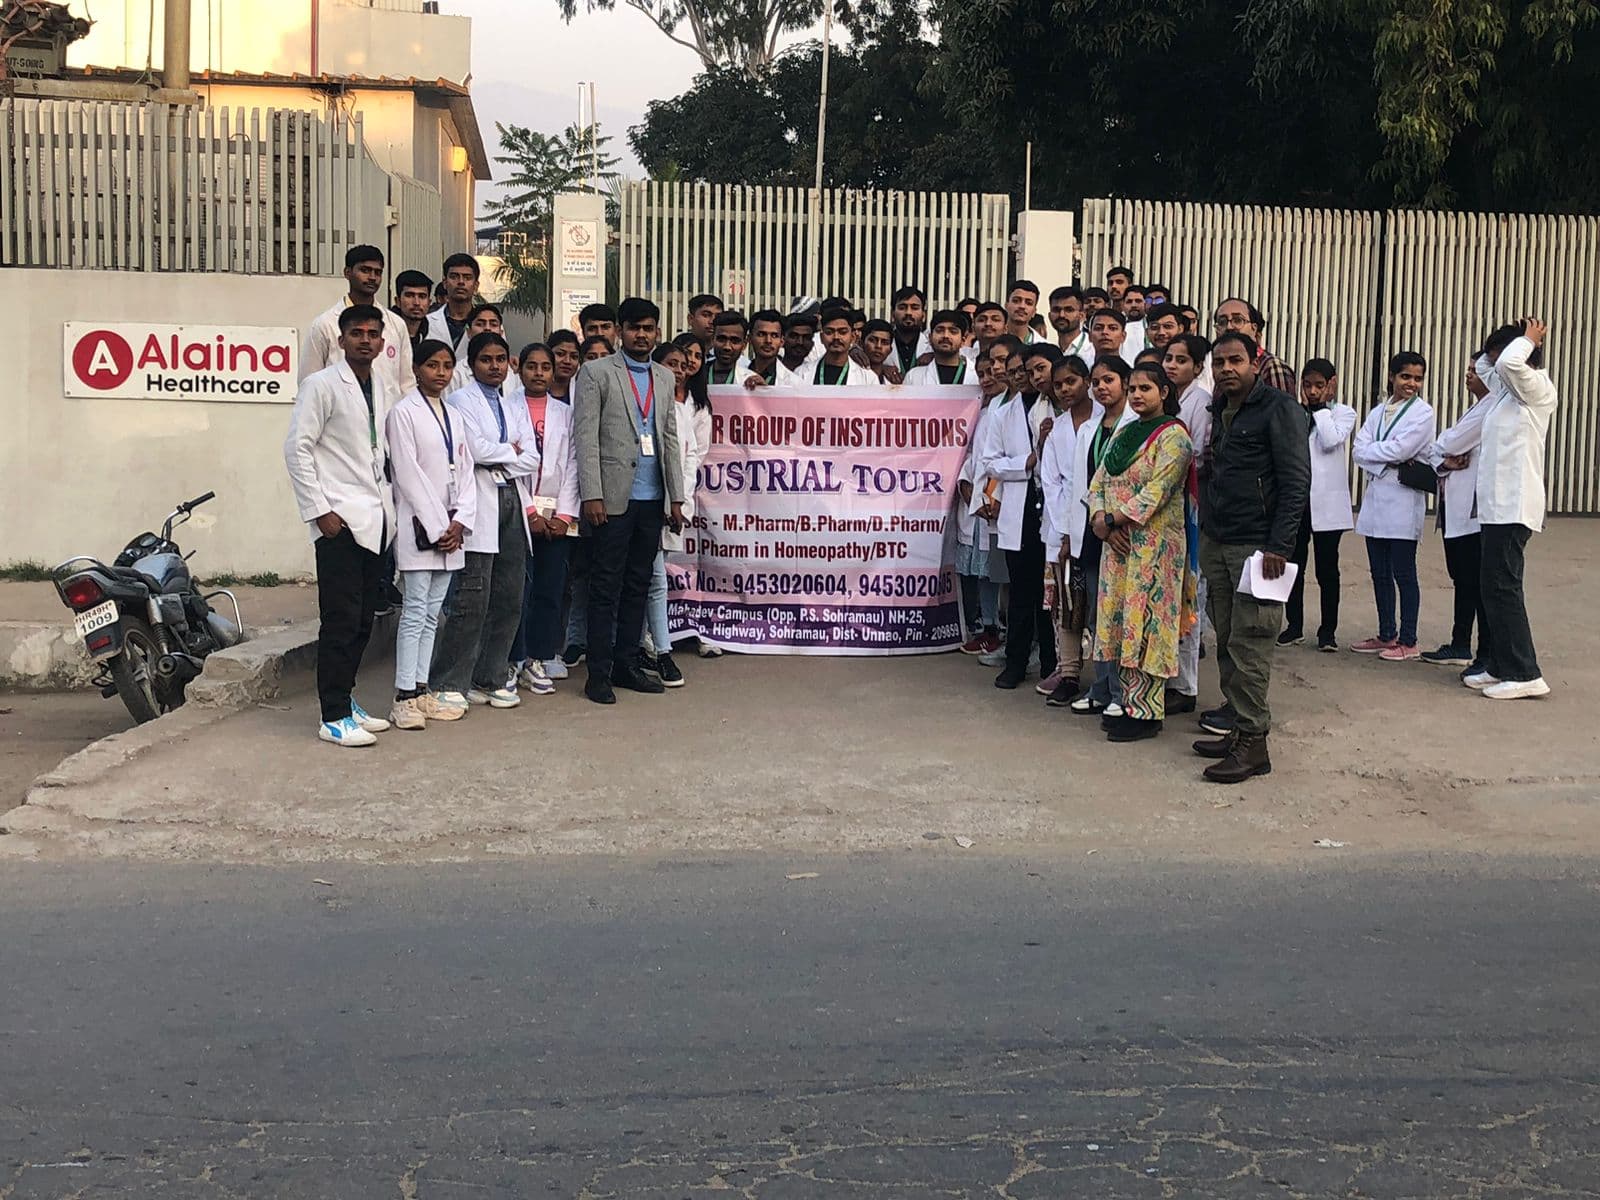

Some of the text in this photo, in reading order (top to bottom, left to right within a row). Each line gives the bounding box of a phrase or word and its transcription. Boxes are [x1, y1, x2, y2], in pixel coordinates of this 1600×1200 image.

[88, 339, 119, 376] A
[137, 333, 290, 373] Alaina
[147, 374, 281, 395] Healthcare
[711, 414, 969, 449] R GROUP OF INSTITUTIONS
[851, 464, 945, 494] TOUR
[723, 514, 947, 535] M.Pharm/B.Pharm/D.Pharm/
[685, 538, 908, 562] D.Pharm in Homeopathy/BTC
[696, 570, 727, 593] No.:
[733, 573, 852, 600] 9453020604,
[80, 612, 113, 634] 1009
[668, 603, 926, 627] Mahadev Campus (Opp. P.S. Sohramau) NH-25,
[687, 618, 709, 635] Ep.
[713, 622, 766, 641] Highway,
[769, 625, 829, 644] Sohramau,
[862, 626, 902, 644] Unnao,
[905, 627, 922, 641] Pin
